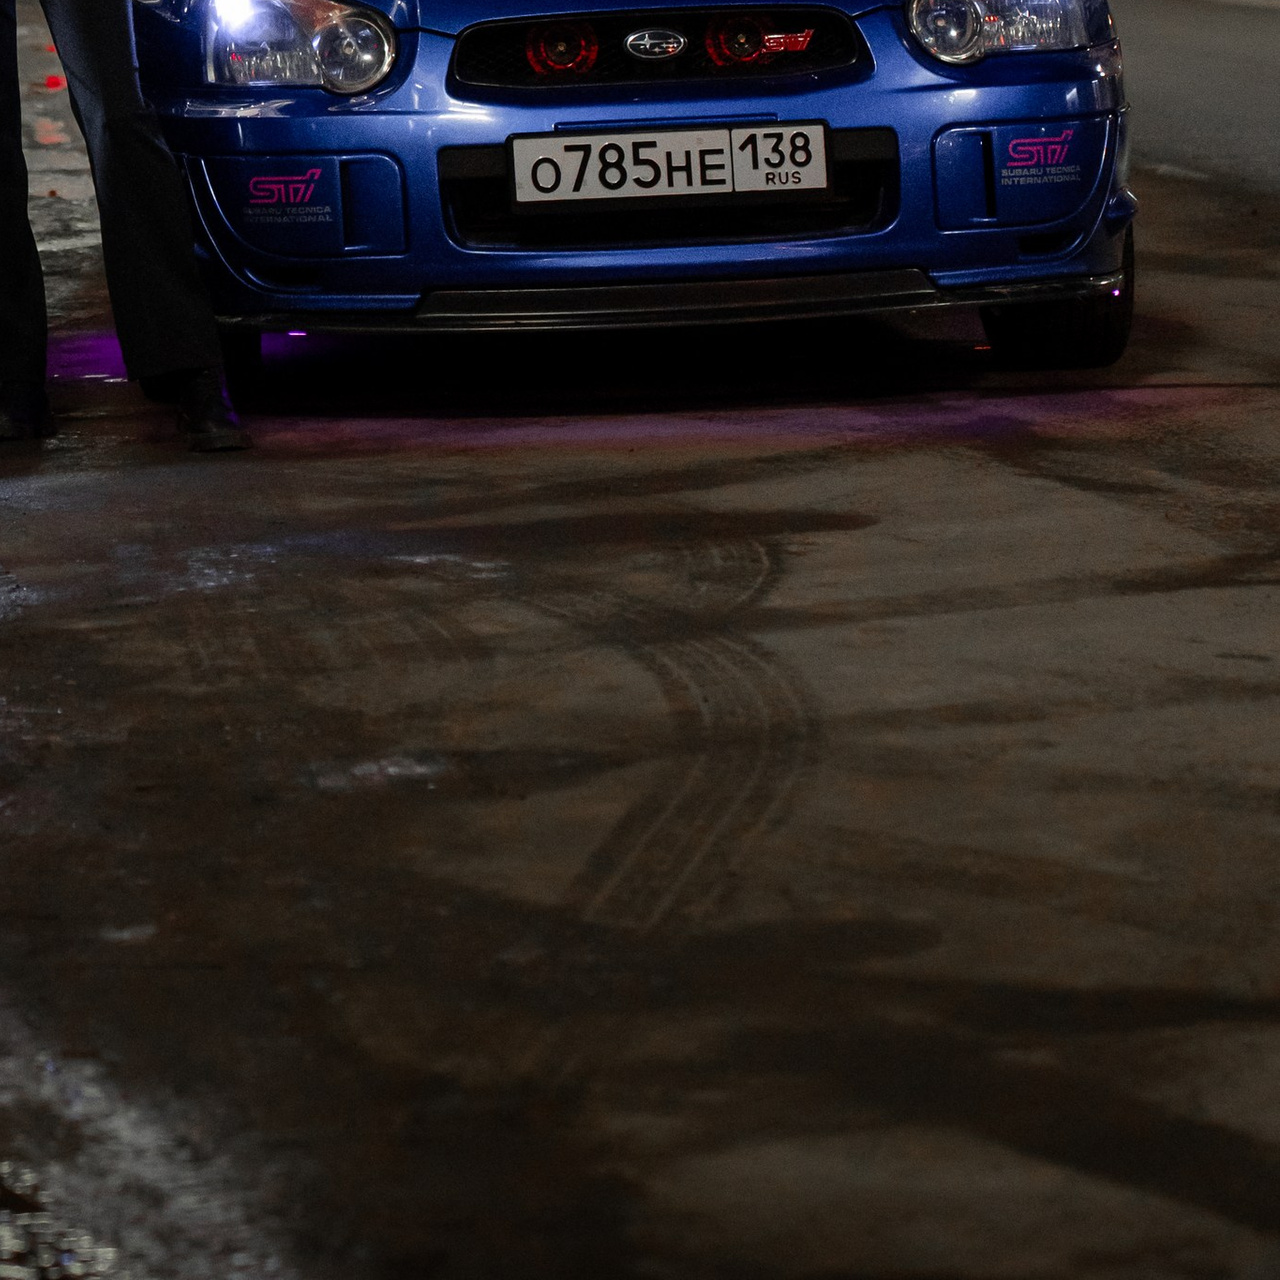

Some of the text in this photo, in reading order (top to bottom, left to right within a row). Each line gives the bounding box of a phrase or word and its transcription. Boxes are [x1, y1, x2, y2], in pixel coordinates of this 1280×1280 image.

[738, 131, 813, 170] 138
[1001, 164, 1081, 177] SUBARU TECNICA
[766, 171, 801, 186] RUS
[1001, 174, 1081, 185] INTERNATIONAL
[286, 205, 332, 215] TECNICA
